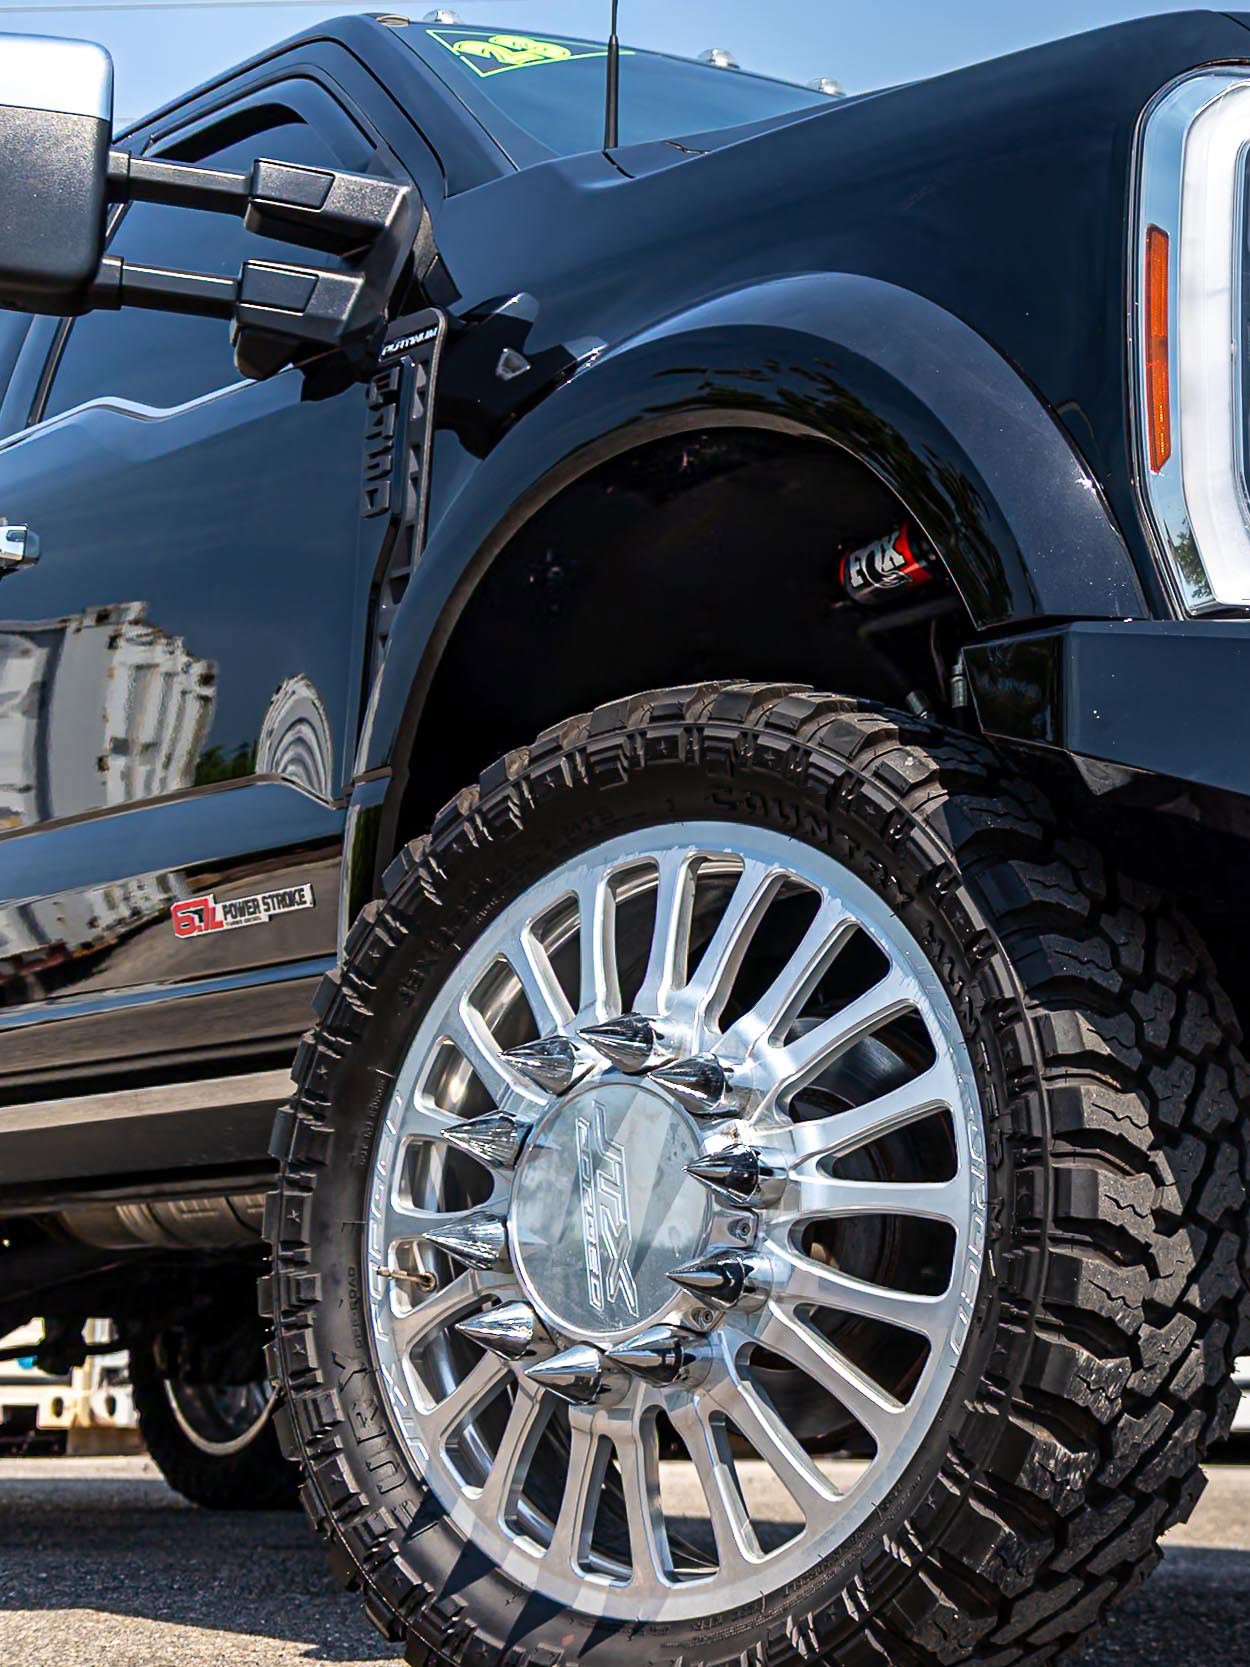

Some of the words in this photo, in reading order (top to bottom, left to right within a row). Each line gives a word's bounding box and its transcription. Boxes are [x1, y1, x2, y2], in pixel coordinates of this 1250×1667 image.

[850, 531, 909, 588] FOX
[222, 897, 261, 920] POWER
[261, 887, 307, 912] STROKE
[576, 1117, 604, 1311] FORGED
[592, 1099, 640, 1318] JTX
[333, 1352, 438, 1540] FURY
